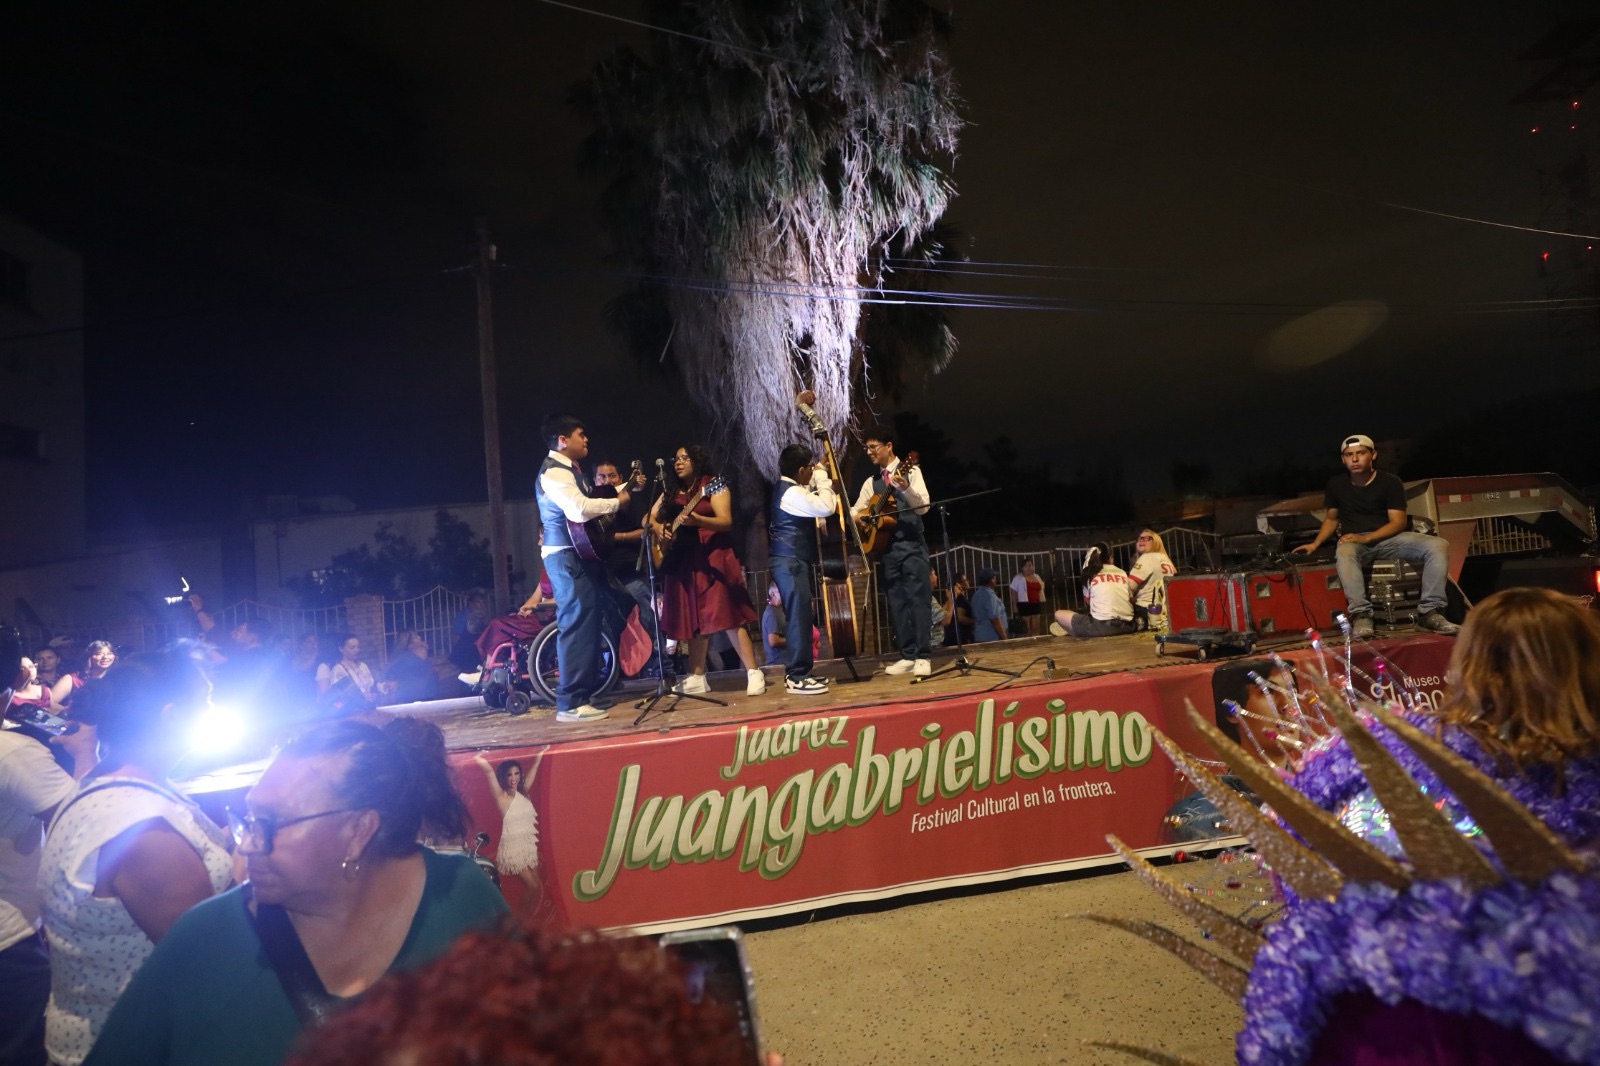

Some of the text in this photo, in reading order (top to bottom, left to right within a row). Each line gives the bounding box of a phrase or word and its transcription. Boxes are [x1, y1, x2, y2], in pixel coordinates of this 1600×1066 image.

[1090, 573, 1127, 586] STAFF
[1403, 675, 1440, 689] Museo
[720, 715, 849, 779] Juárez
[572, 698, 1152, 902] Juangabrielísimo
[911, 781, 1117, 834] Festival Cultural en la frontera.
